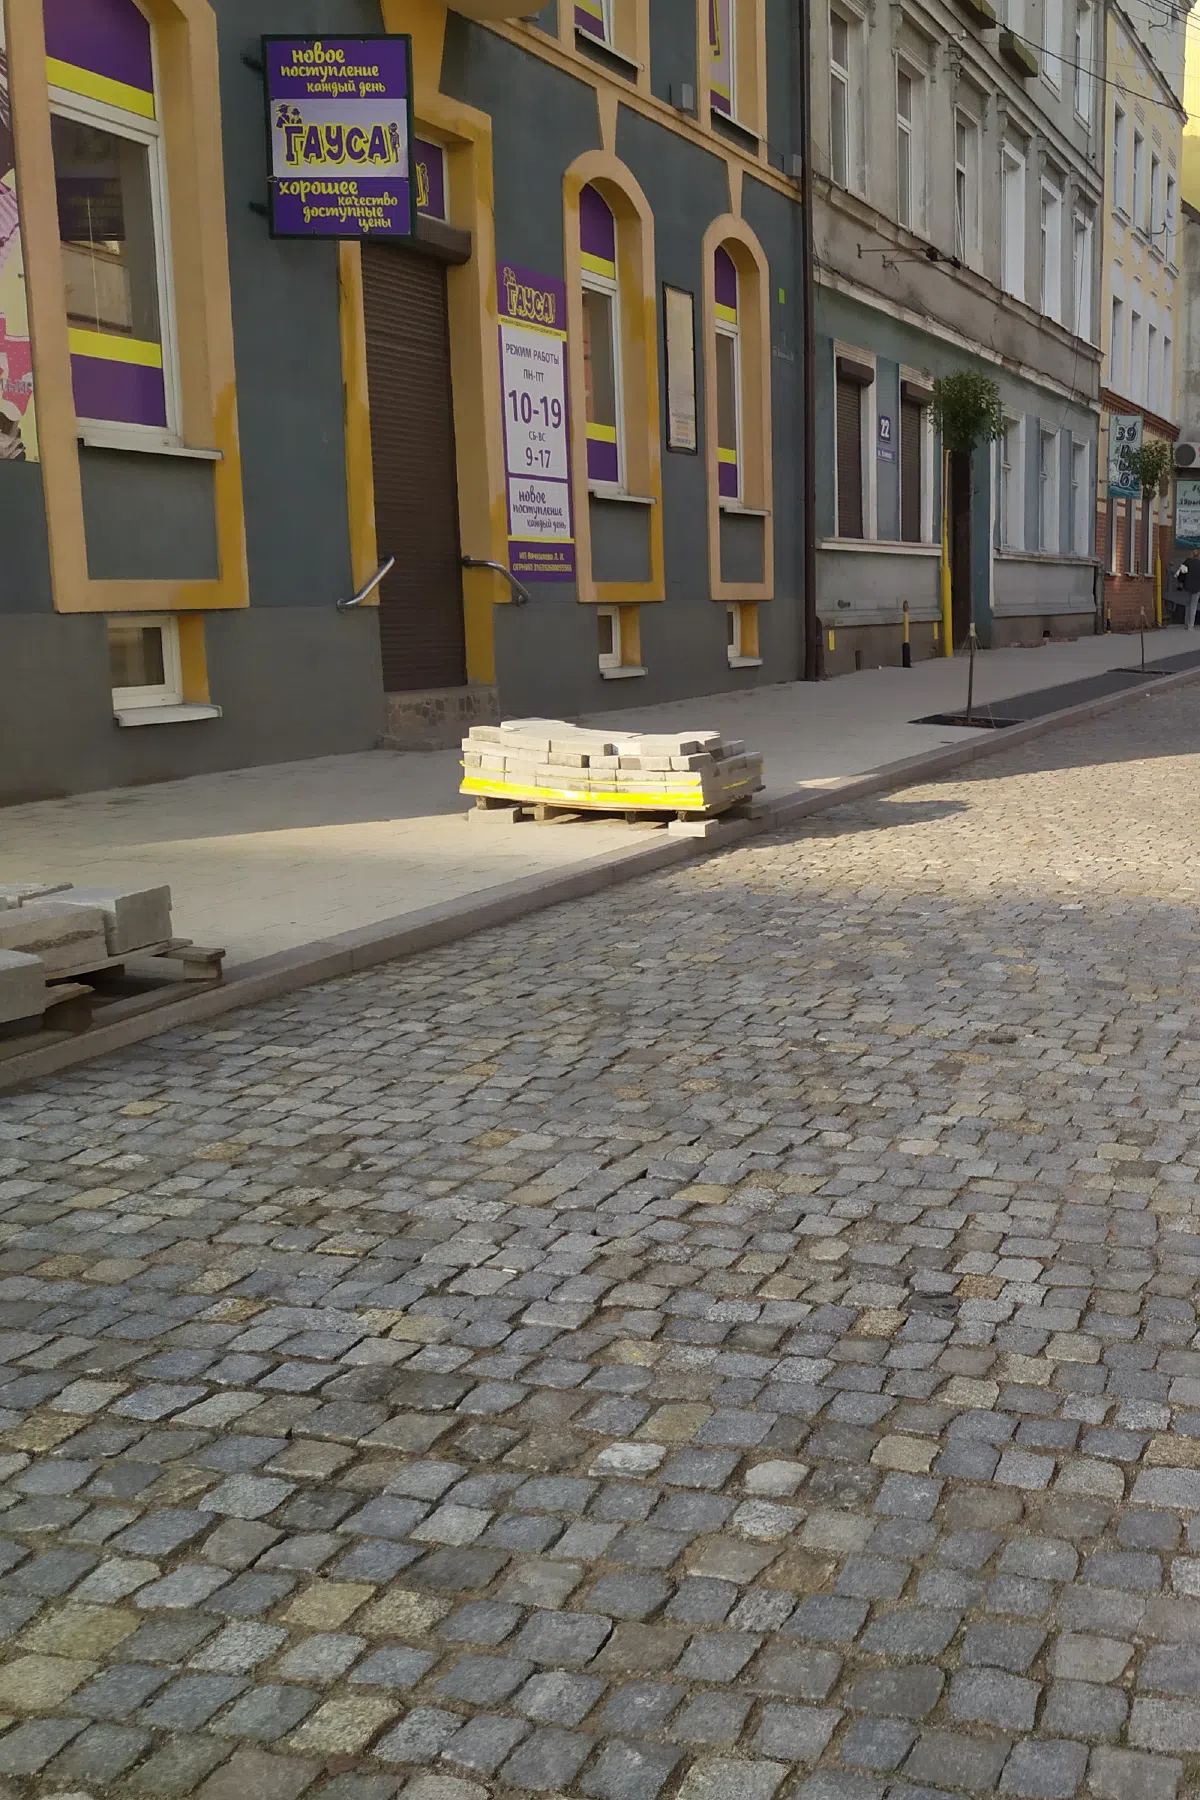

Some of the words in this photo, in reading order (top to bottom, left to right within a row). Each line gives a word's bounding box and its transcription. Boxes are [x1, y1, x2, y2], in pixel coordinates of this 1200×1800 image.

[292, 41, 345, 64] новое
[280, 64, 380, 83] поступление
[306, 79, 356, 97] каждый
[359, 81, 386, 98] день
[283, 123, 392, 168] ГАУСА
[278, 180, 358, 202] хорошее
[338, 192, 398, 206] качество
[303, 204, 384, 223] доступные
[358, 217, 392, 232] цены
[507, 282, 553, 324] ГАУСА
[505, 343, 532, 359] РЕЖИМ
[533, 349, 560, 365] РАБОТЫ
[523, 368, 544, 382] ПН-ПТ
[508, 388, 562, 429] 10-19
[528, 430, 546, 442] СБ-ВС
[1115, 425, 1137, 443] 39
[526, 446, 551, 469] 9-17
[519, 485, 546, 504] новое
[513, 504, 562, 519] поступление
[527, 519, 552, 533] каждый
[552, 521, 566, 533] день
